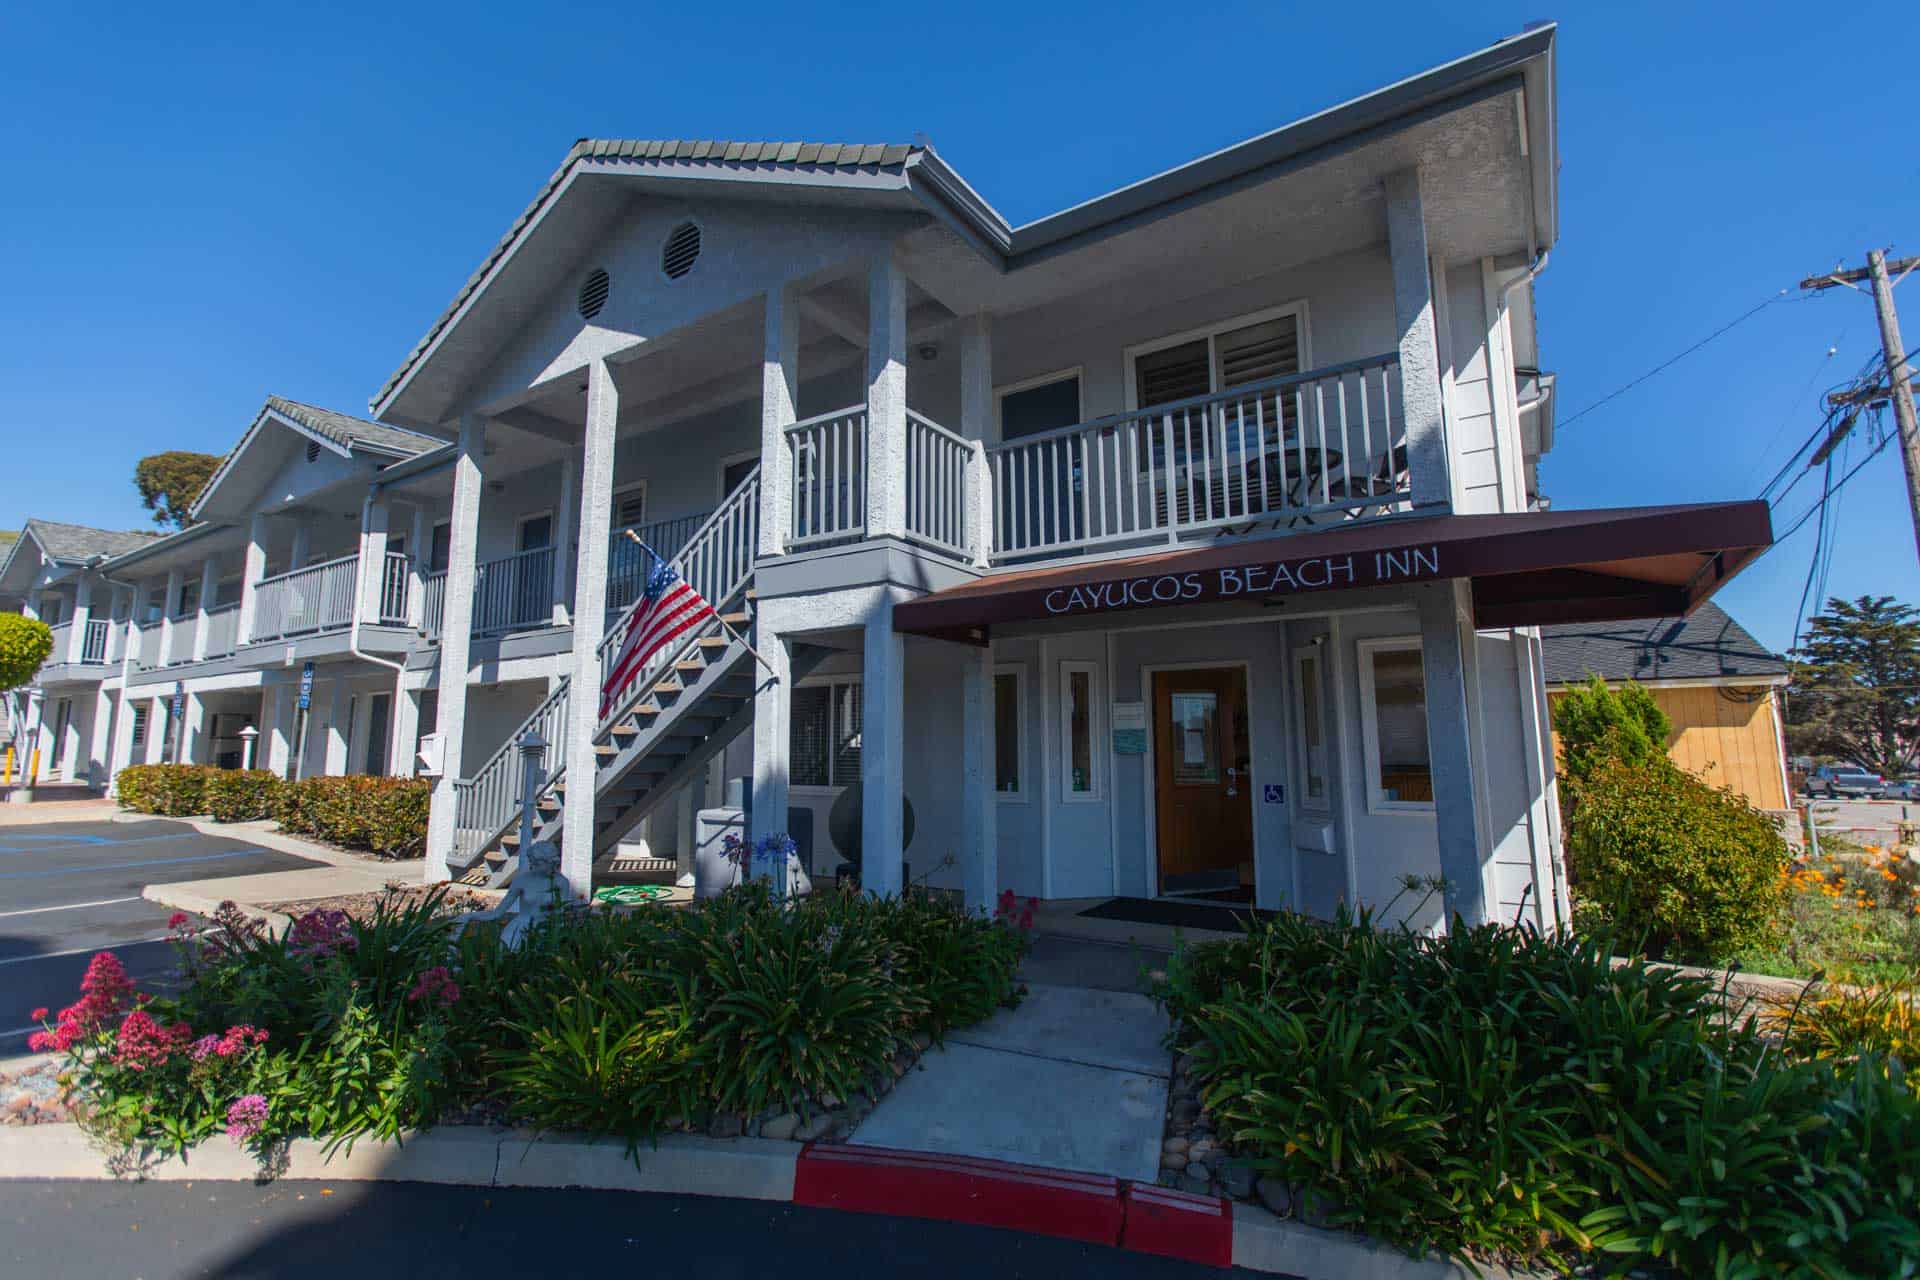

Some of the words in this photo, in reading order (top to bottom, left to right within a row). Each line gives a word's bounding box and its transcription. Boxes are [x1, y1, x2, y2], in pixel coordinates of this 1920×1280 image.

[1045, 573, 1203, 613] CAYUCOS
[1219, 556, 1354, 595] BEACH
[1375, 546, 1439, 580] INN
